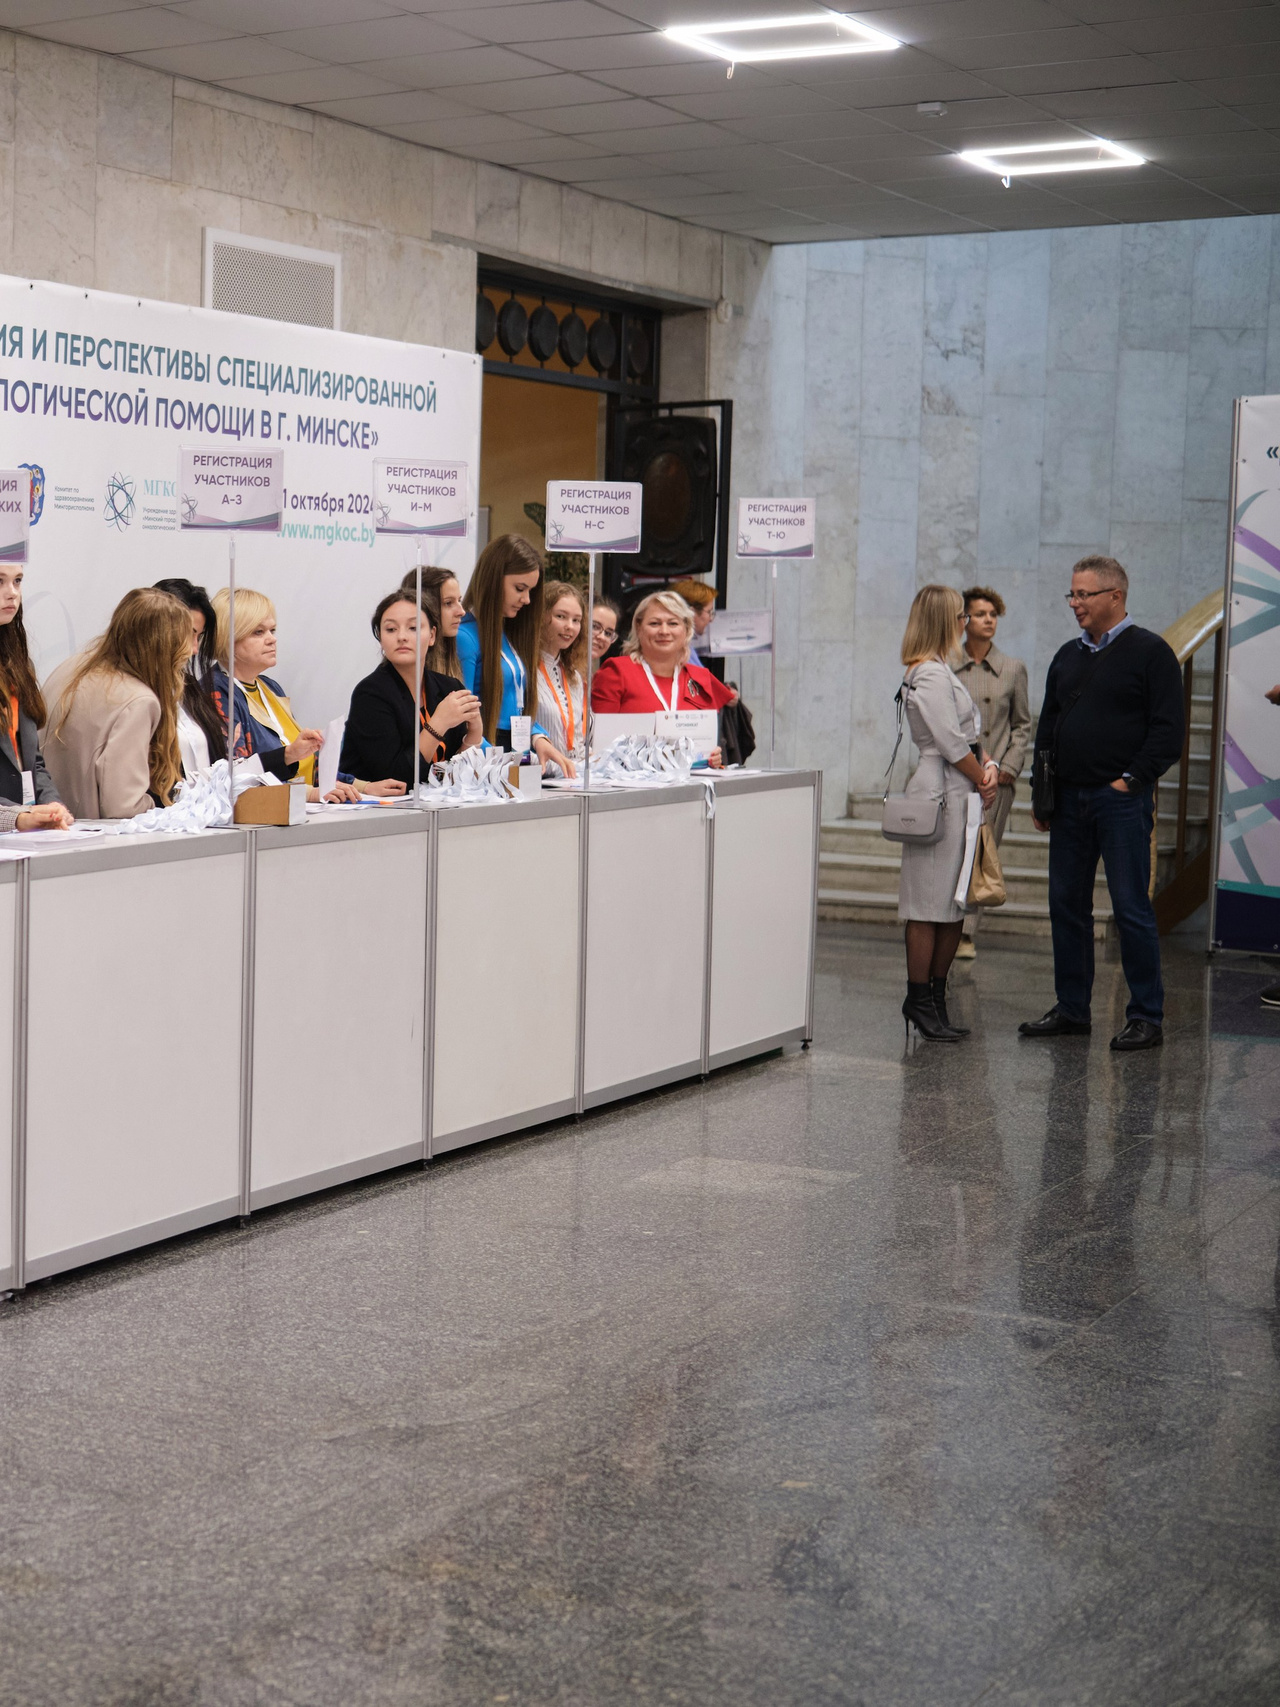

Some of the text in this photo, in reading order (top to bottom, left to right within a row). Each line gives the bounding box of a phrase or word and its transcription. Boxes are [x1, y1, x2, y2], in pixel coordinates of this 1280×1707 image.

[31, 328, 48, 362] И
[54, 331, 211, 384] ПЕРСПЕКТИВЫ
[216, 355, 437, 414] СПЕЦИАЛИЗИРОВАННОЙ
[155, 397, 255, 441] ПОМОЩИ
[260, 410, 272, 439] В
[277, 411, 291, 442] Г.
[296, 414, 379, 450] МИНСКЕ»
[193, 455, 273, 470] РЕГИСТРАЦИЯ
[386, 466, 458, 480] РЕГИСТРАЦИЯ
[194, 474, 271, 487] УЧАСТНИКОВ
[388, 483, 456, 497] УЧАСТНИКОВ
[560, 489, 632, 501] РЕГИСТРАЦИЯ
[291, 491, 344, 517] октября
[561, 504, 630, 515] УЧАСТНИКОВ
[747, 503, 807, 513] РЕГИСТРАЦИЯ
[748, 517, 806, 526] УЧАСТНИКОВ
